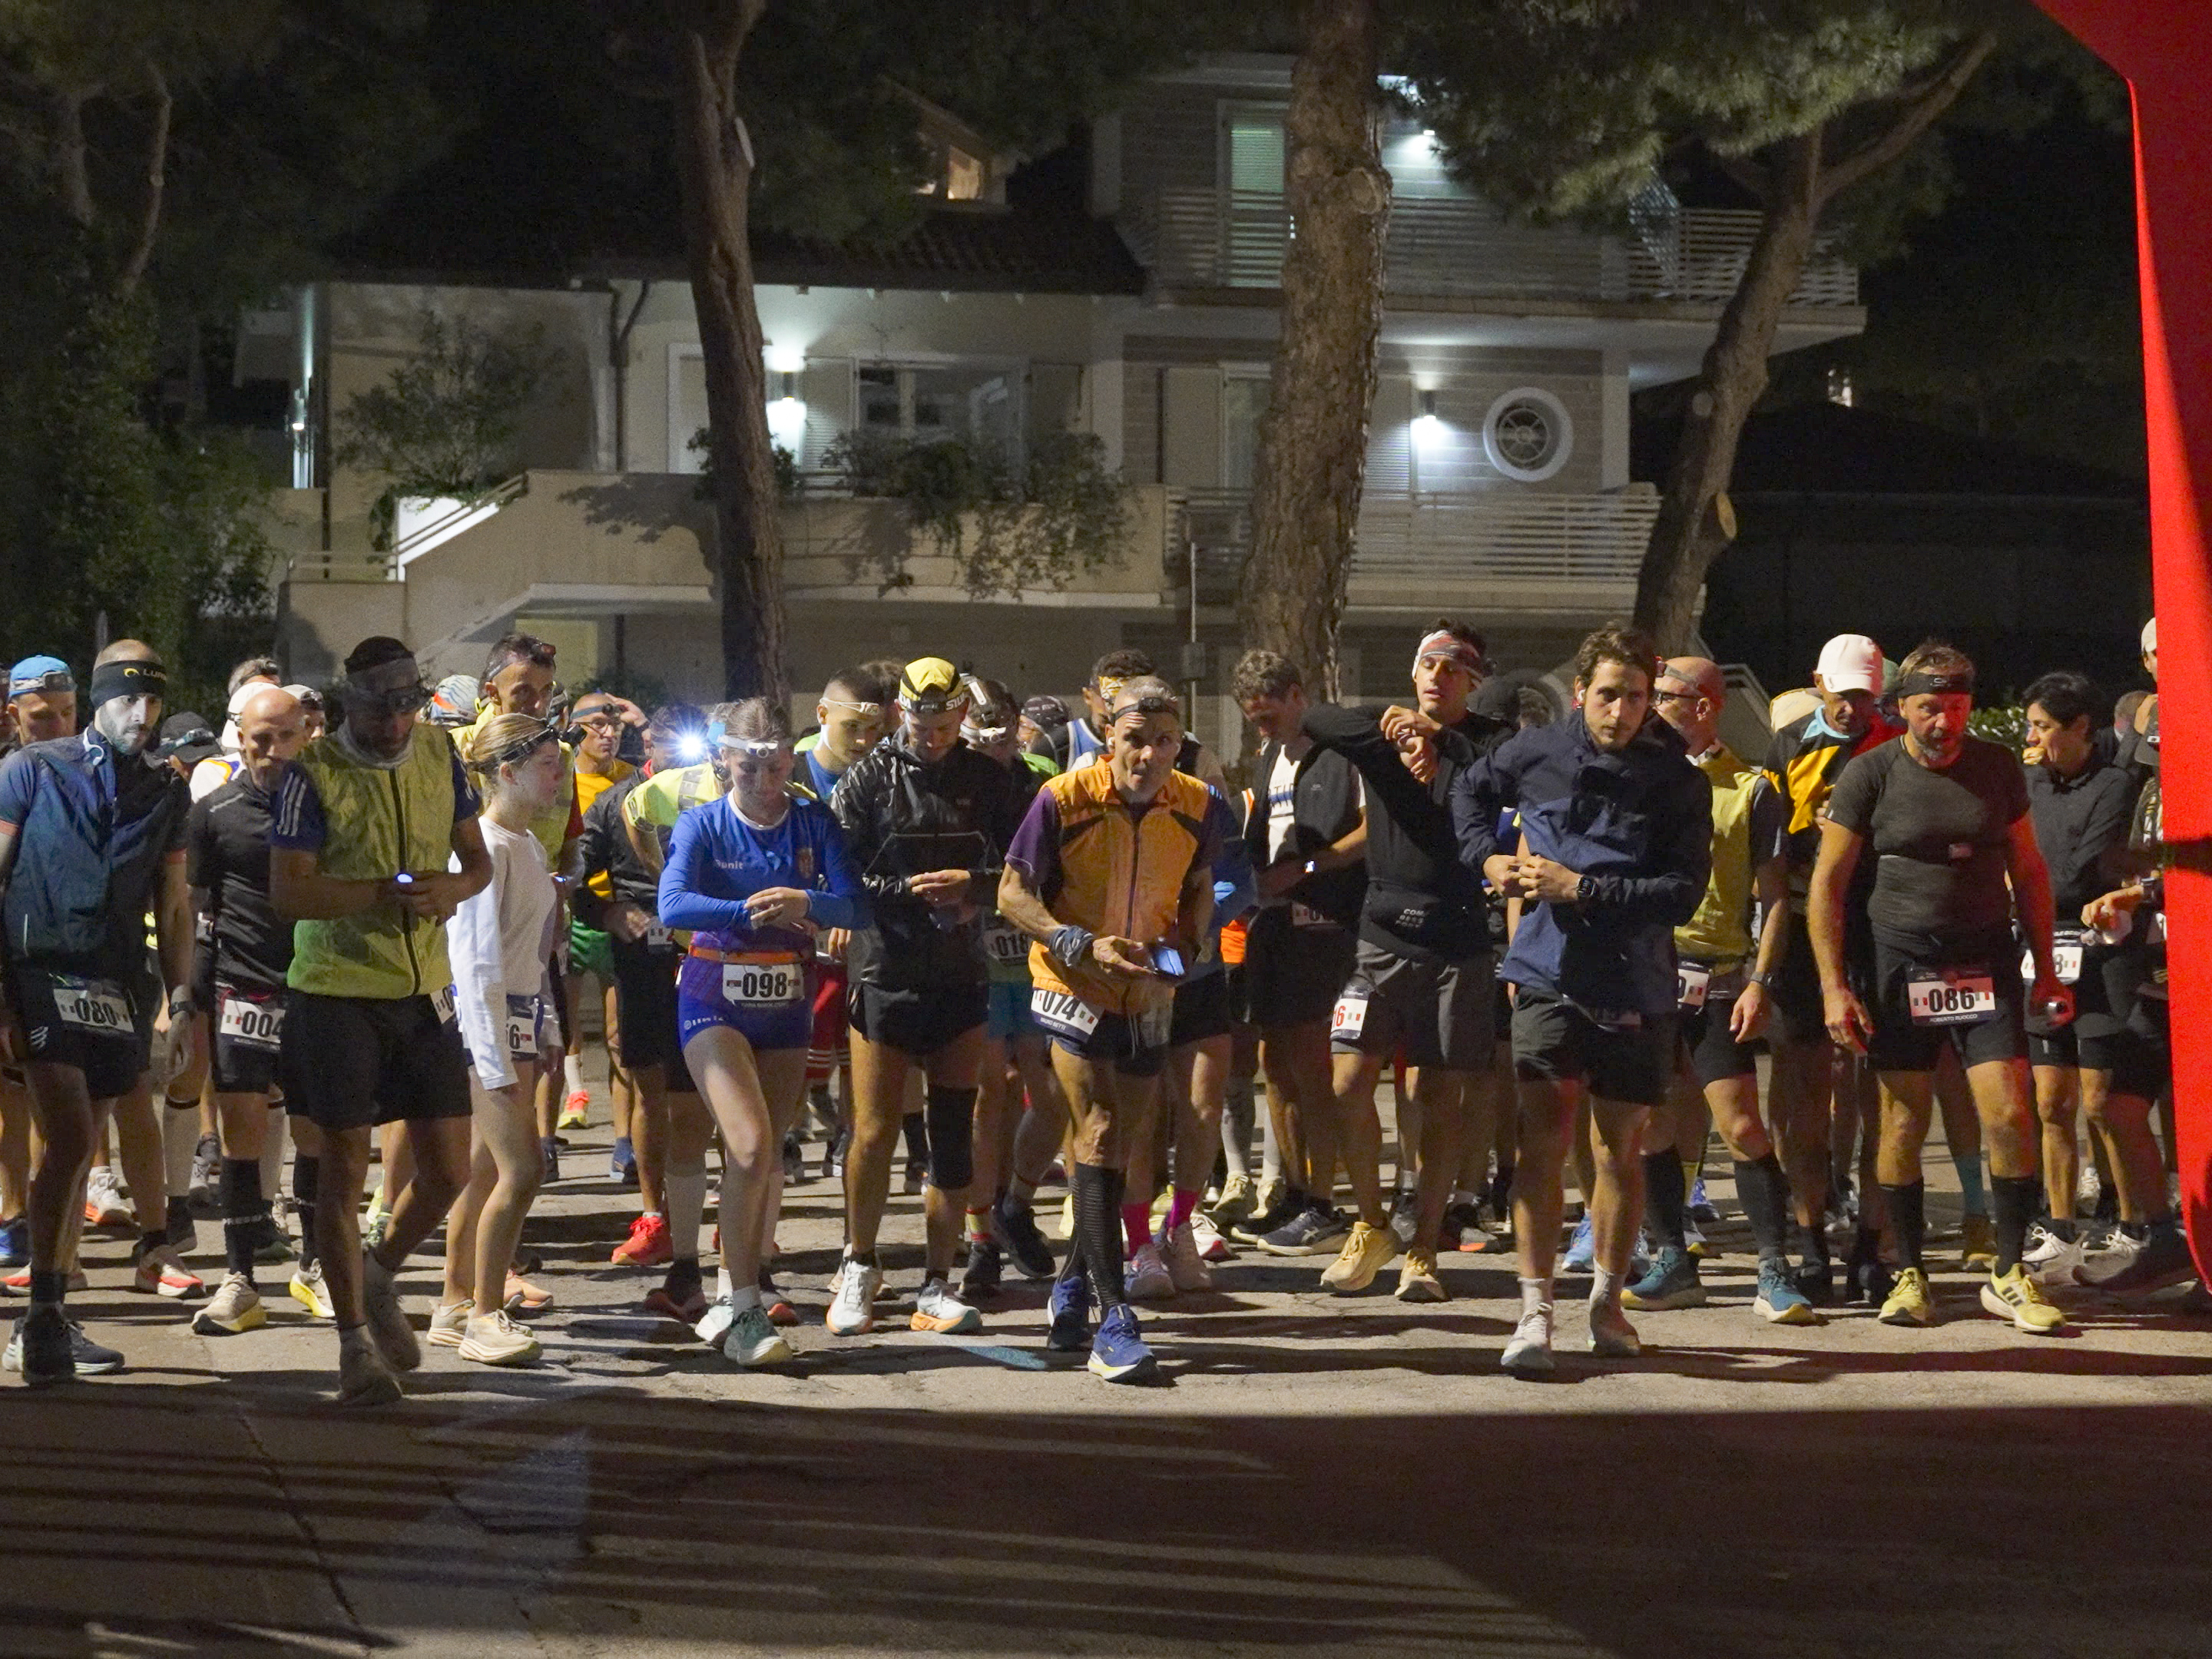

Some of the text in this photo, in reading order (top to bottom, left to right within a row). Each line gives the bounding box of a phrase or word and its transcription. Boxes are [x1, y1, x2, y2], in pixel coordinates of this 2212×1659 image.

[743, 972, 786, 998] 098
[75, 998, 118, 1026] 080
[1041, 990, 1081, 1021] 074
[1929, 986, 1975, 1013] 086
